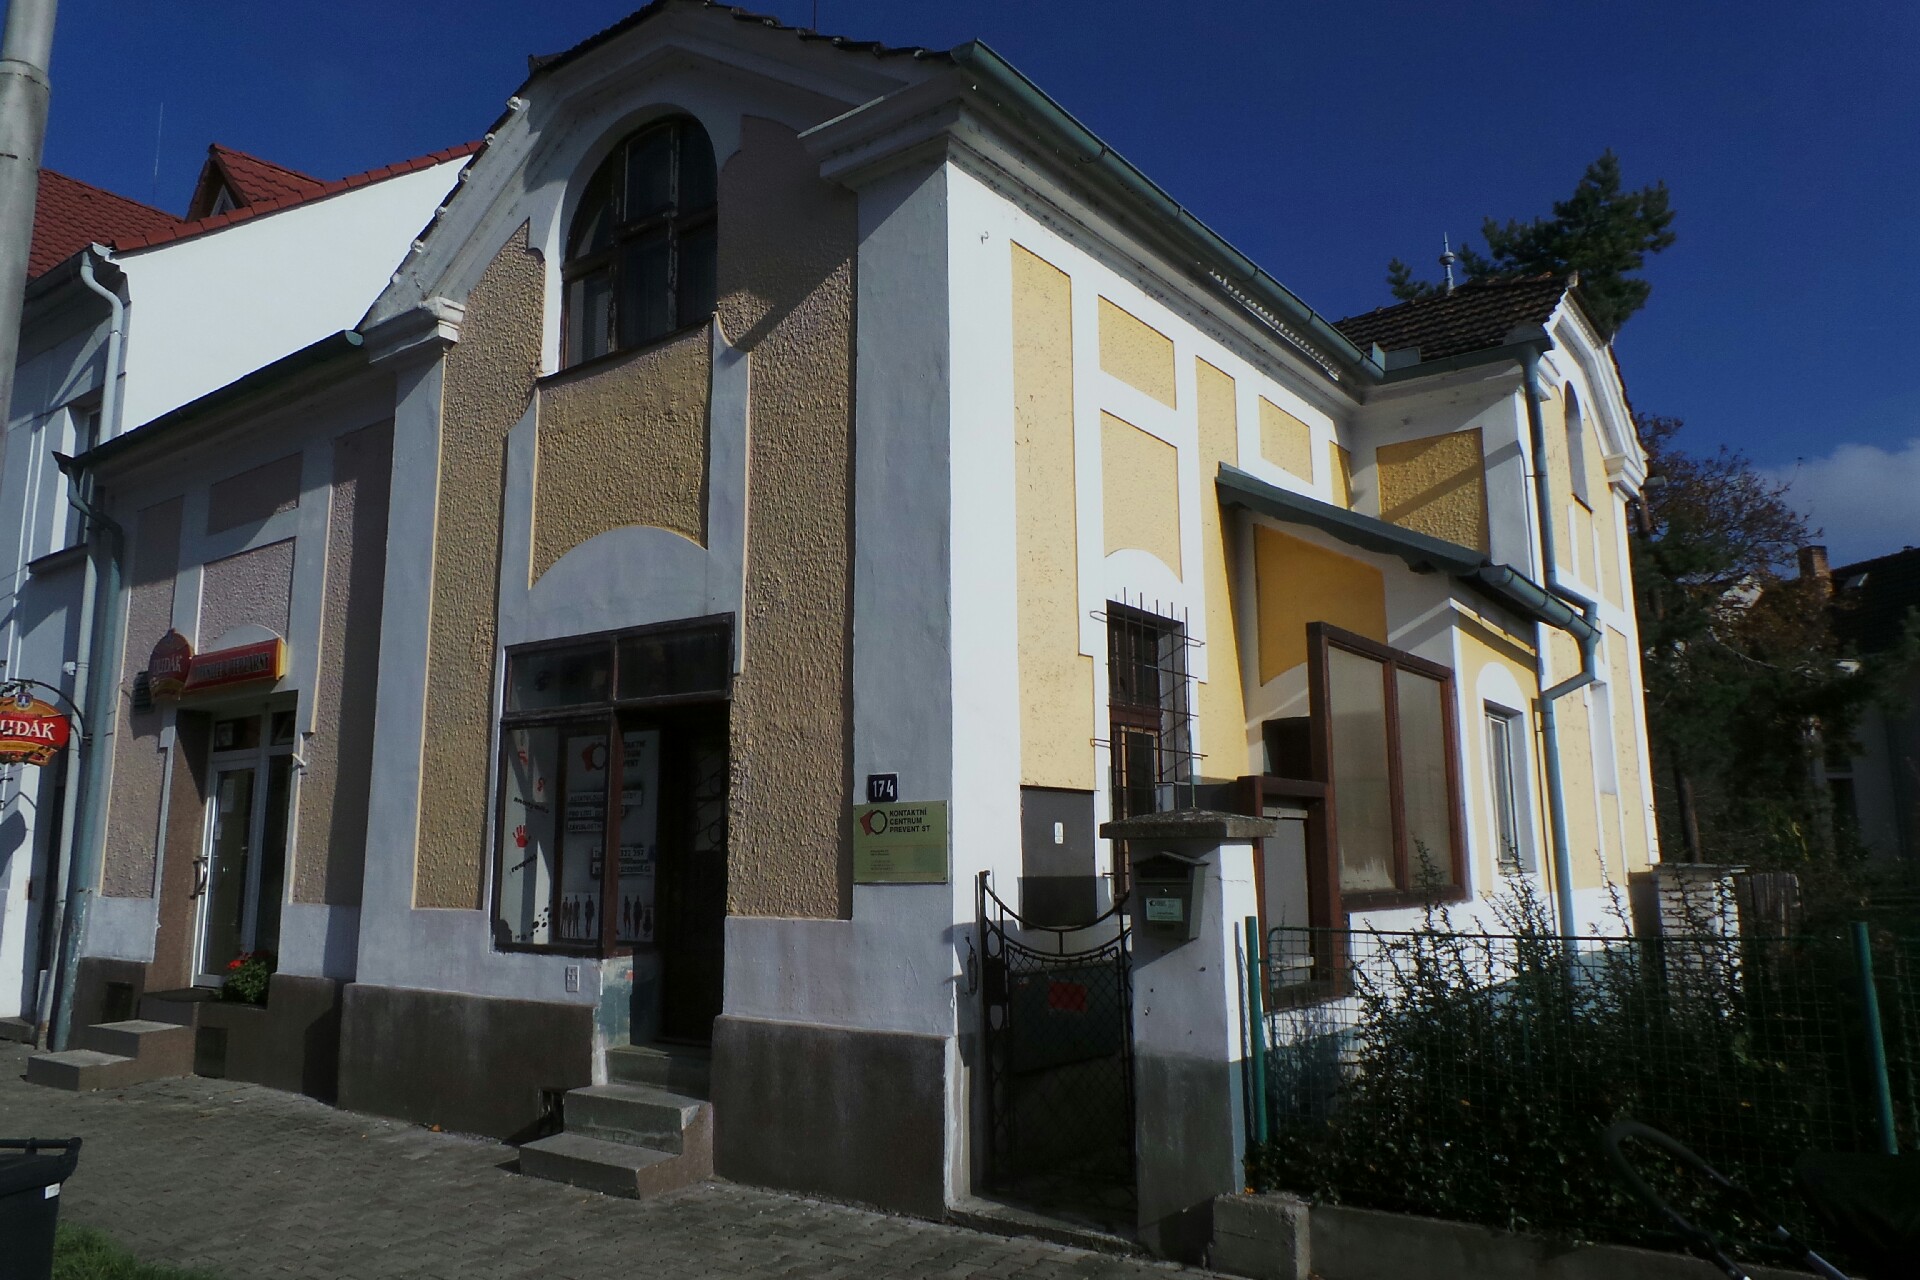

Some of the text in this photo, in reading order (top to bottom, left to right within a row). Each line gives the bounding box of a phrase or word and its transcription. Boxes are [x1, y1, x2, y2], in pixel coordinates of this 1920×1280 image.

[0, 720, 56, 741] UDÁK
[872, 779, 894, 798] 174
[889, 807, 927, 817] KONTAKTNÍ
